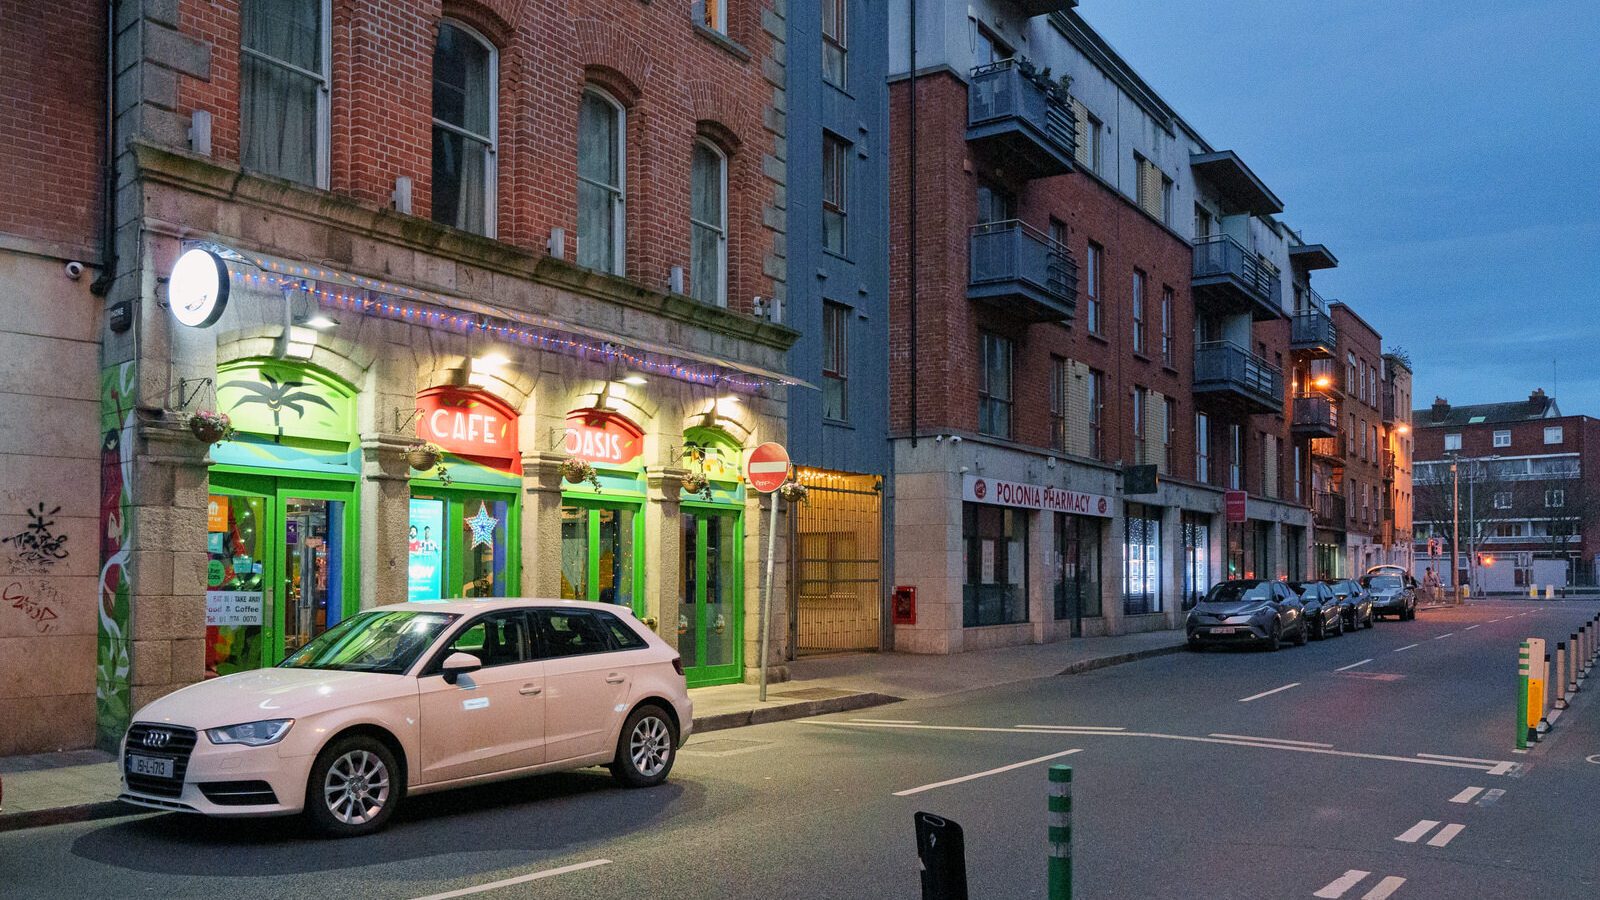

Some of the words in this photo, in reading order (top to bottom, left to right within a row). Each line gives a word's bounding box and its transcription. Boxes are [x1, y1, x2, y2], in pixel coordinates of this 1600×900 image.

[430, 408, 497, 444] CAFE
[565, 428, 622, 460] OASIS
[996, 482, 1040, 508] POLONIA
[1043, 488, 1091, 513] PHARMACY
[207, 605, 222, 613] ood
[234, 605, 260, 613] Coffee
[234, 595, 247, 603] TAKE
